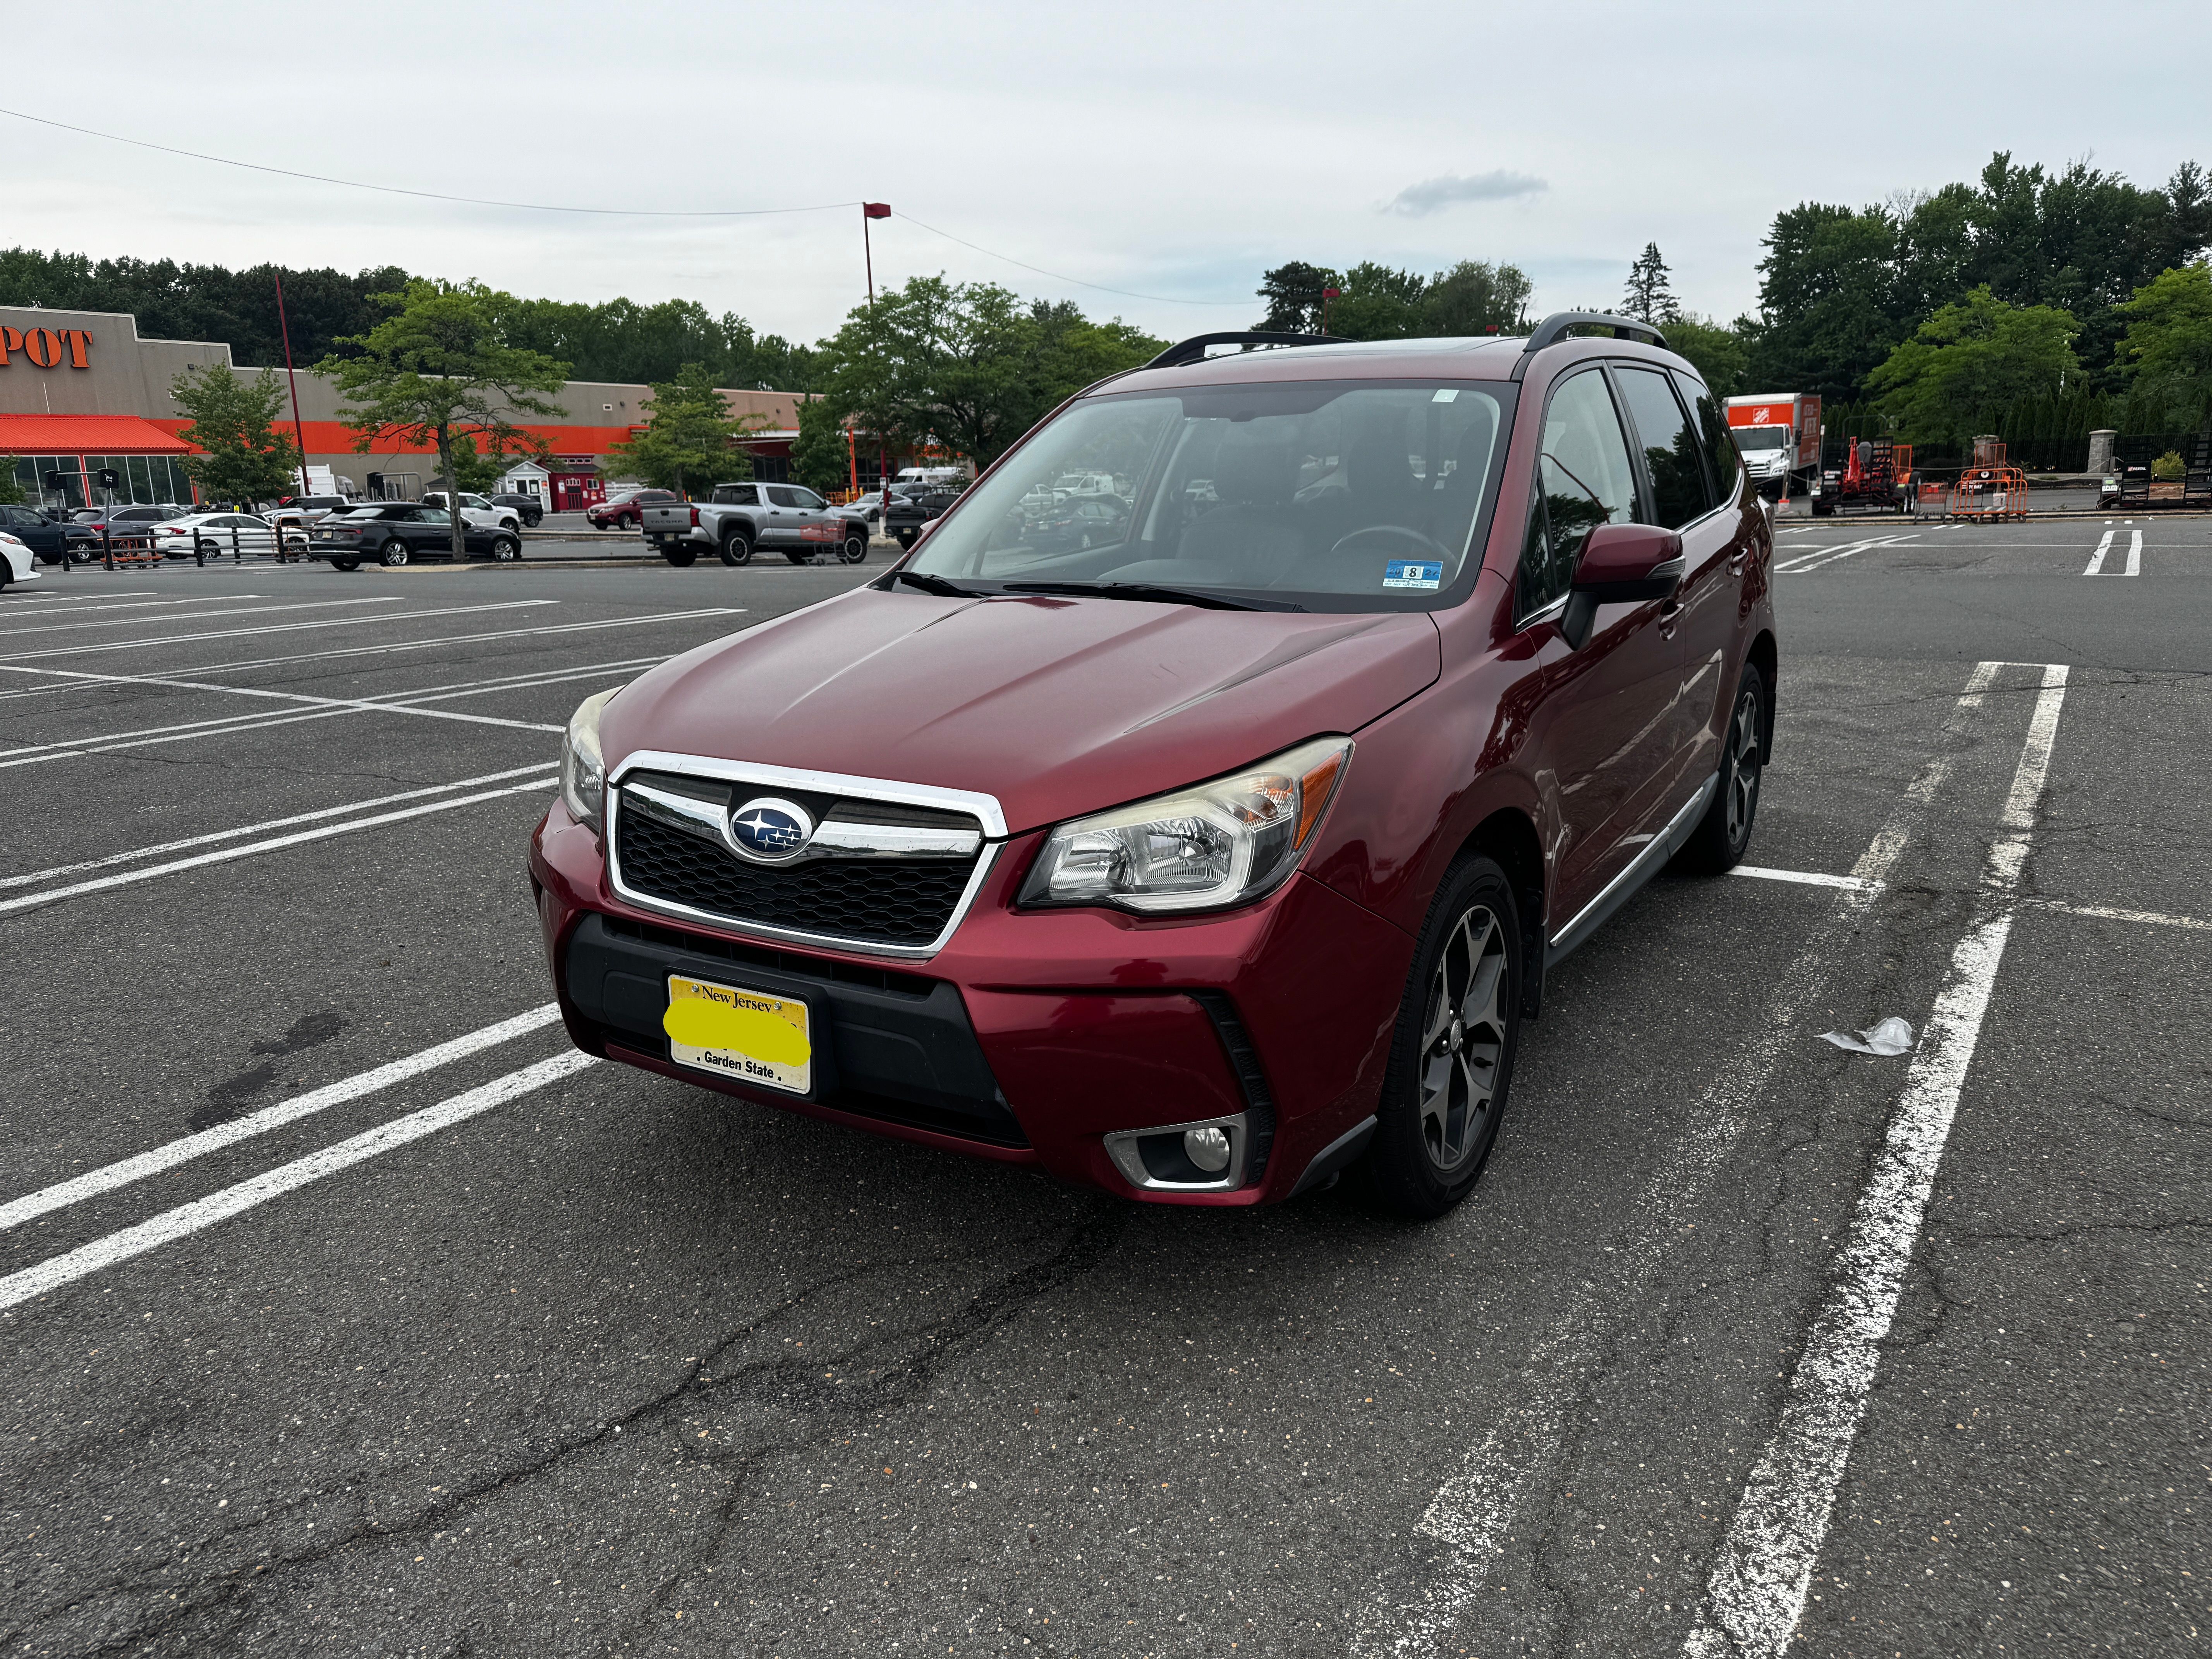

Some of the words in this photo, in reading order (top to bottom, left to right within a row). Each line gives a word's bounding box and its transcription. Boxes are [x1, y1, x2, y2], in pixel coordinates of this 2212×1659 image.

[0, 326, 93, 368] POT
[1409, 567, 1417, 577] 8
[701, 985, 731, 1003] New
[733, 992, 772, 1013] Jersey
[704, 1051, 742, 1070] Garden
[745, 1060, 774, 1078] State
